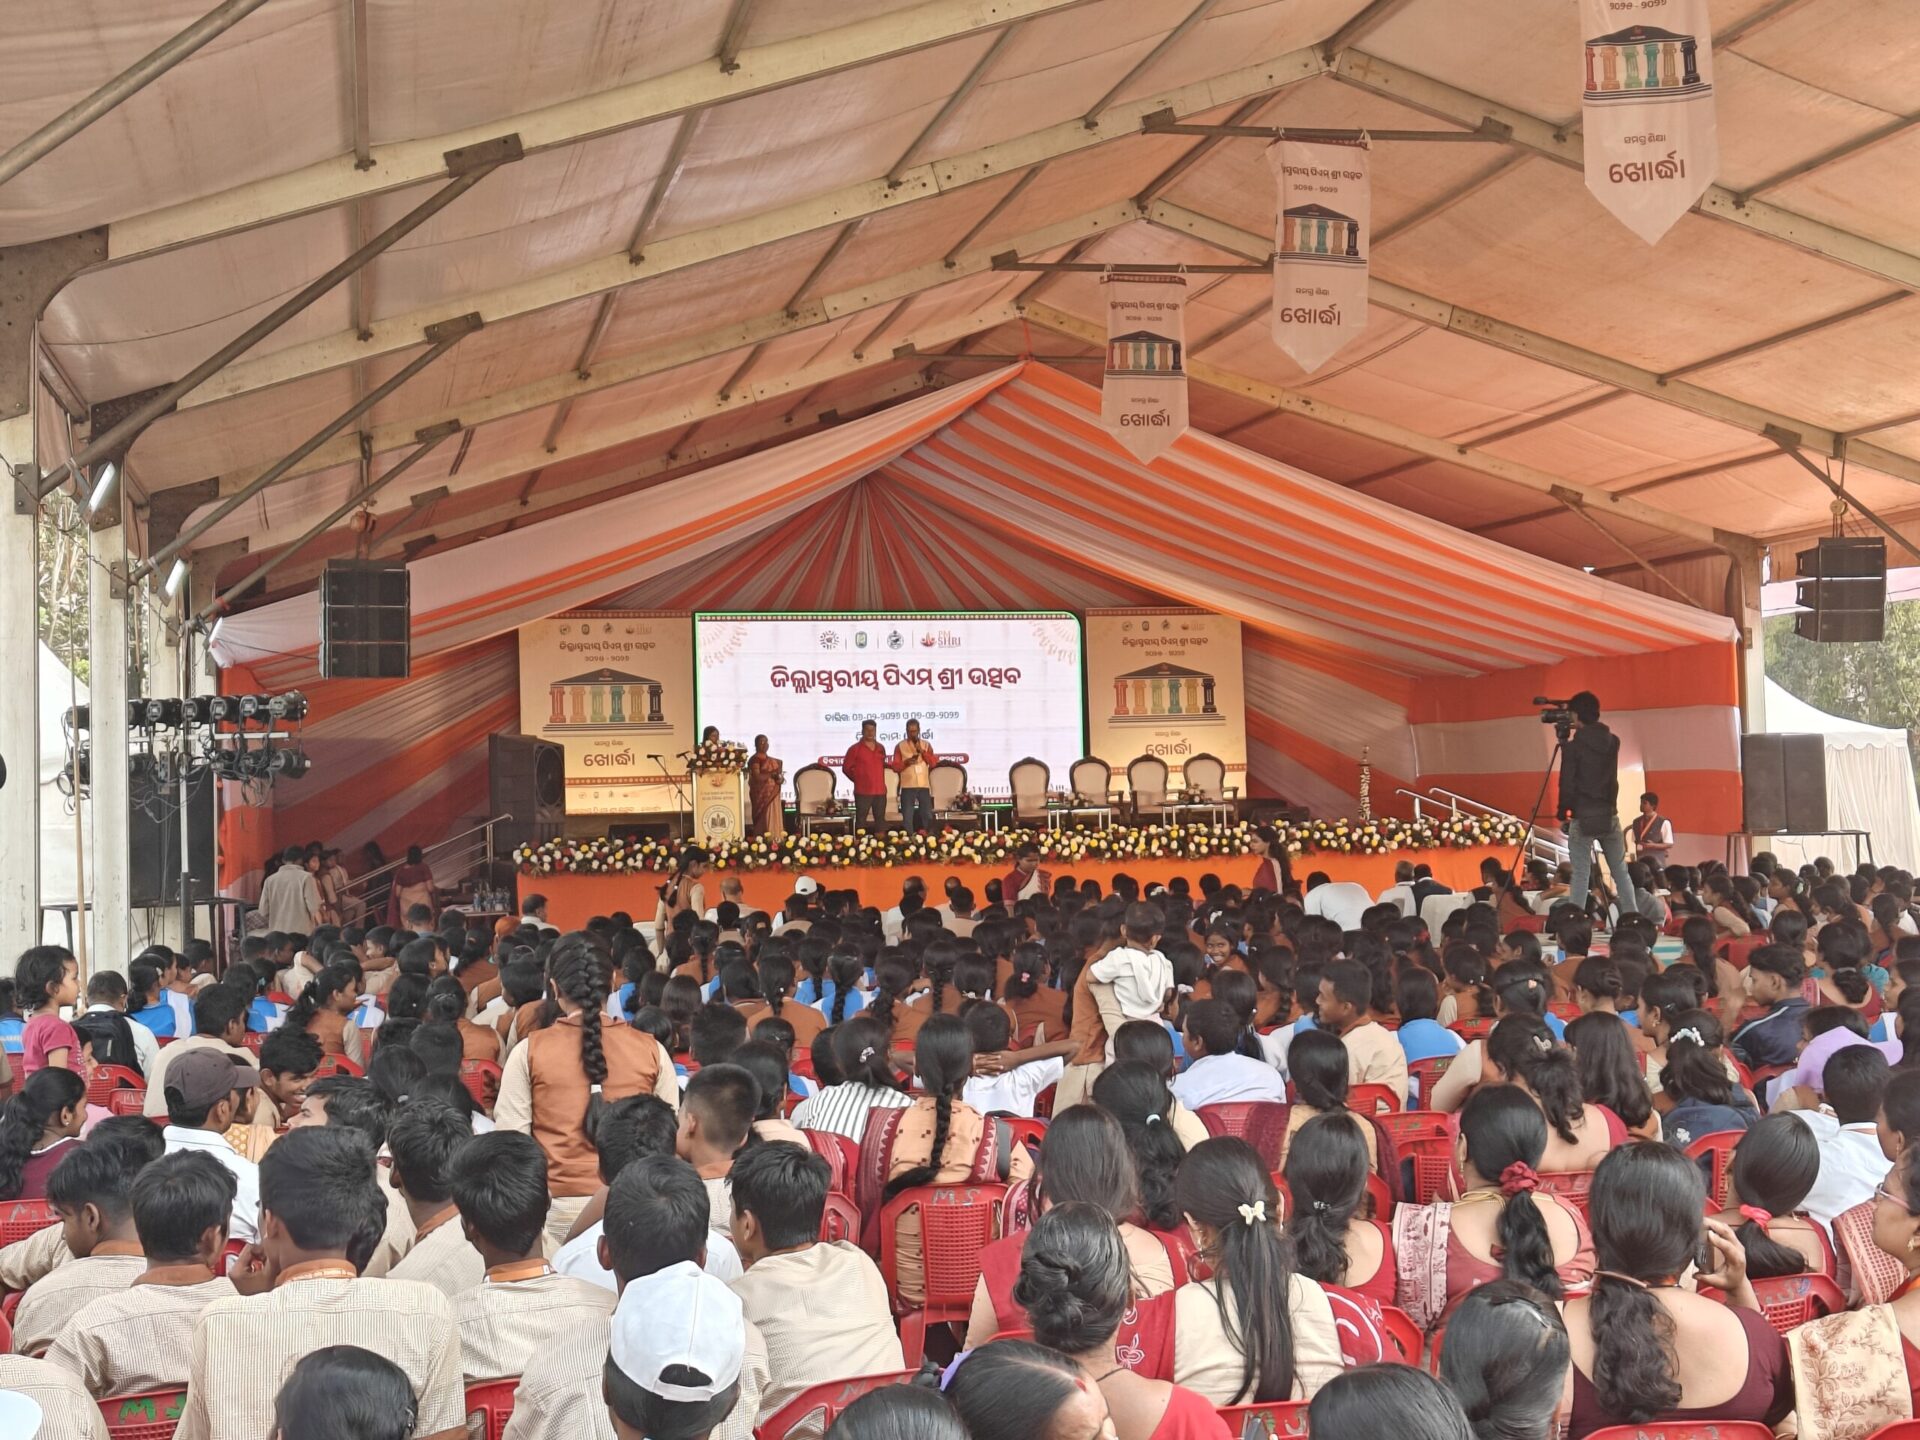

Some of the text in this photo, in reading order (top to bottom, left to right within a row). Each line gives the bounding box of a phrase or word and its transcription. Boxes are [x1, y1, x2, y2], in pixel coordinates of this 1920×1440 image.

[770, 664, 1022, 694] ଜିଲ୍ଲାସ୍ତରୀୟ ପିଏମ୍ ଶ୍ରୀ ଉତ୍ସବ
